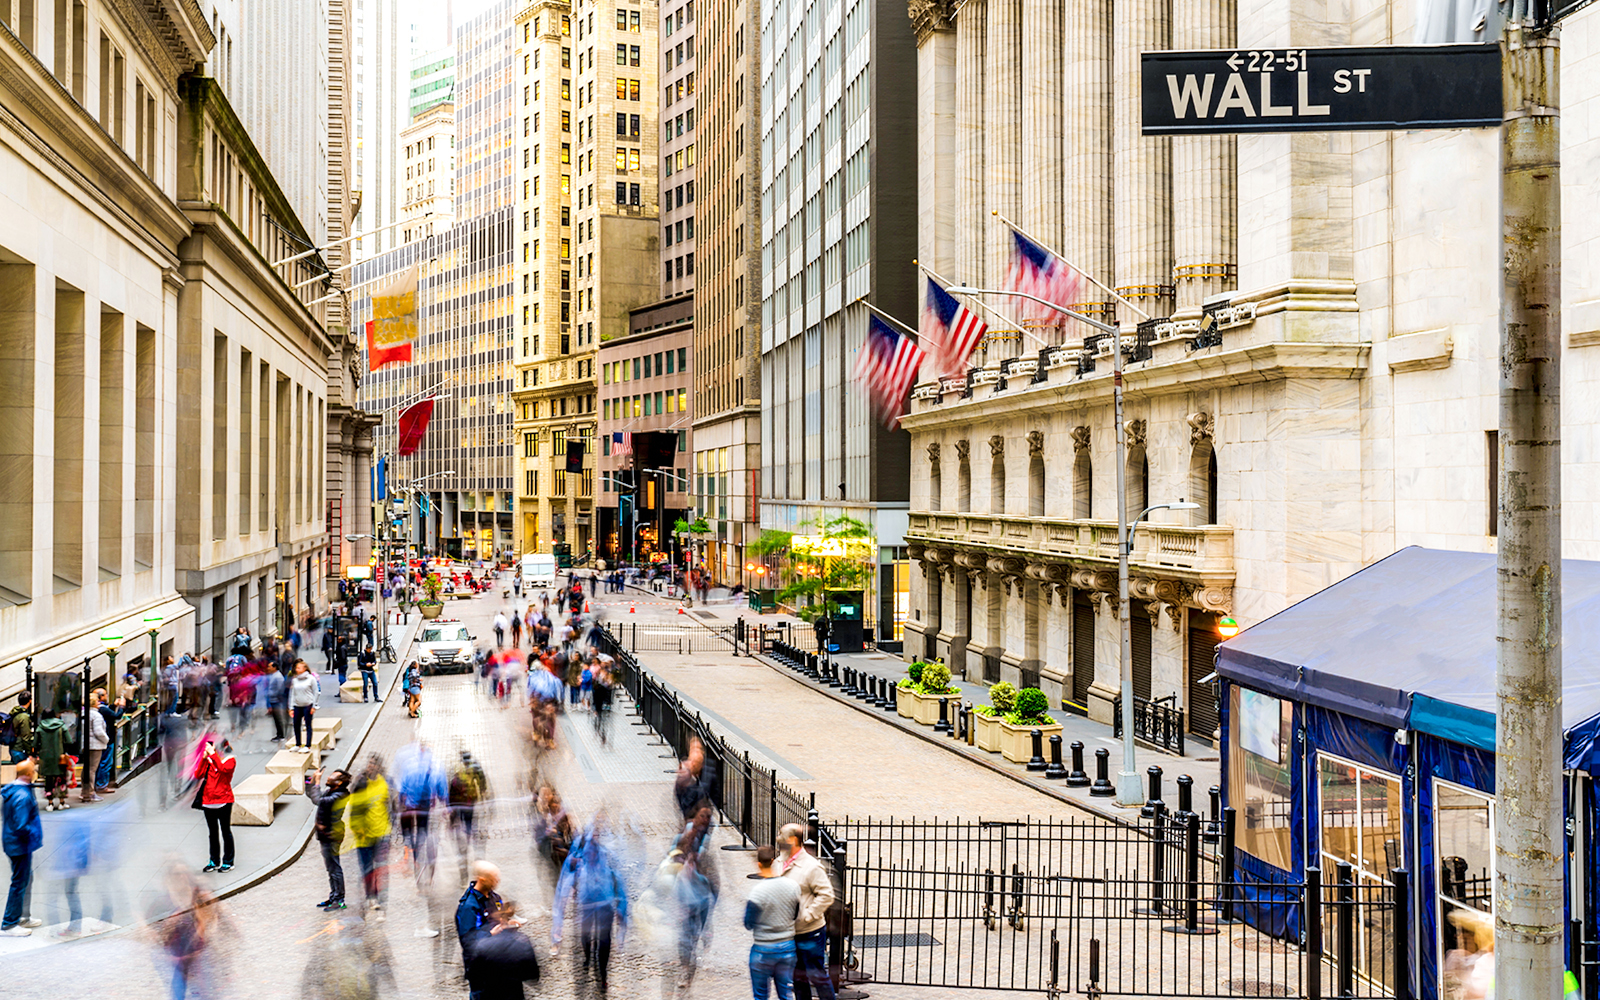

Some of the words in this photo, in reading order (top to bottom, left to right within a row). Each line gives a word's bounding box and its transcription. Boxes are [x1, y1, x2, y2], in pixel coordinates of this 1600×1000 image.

[1247, 50, 1307, 72] 22-51
[1166, 71, 1331, 119] WALL
[1333, 69, 1372, 94] ST
